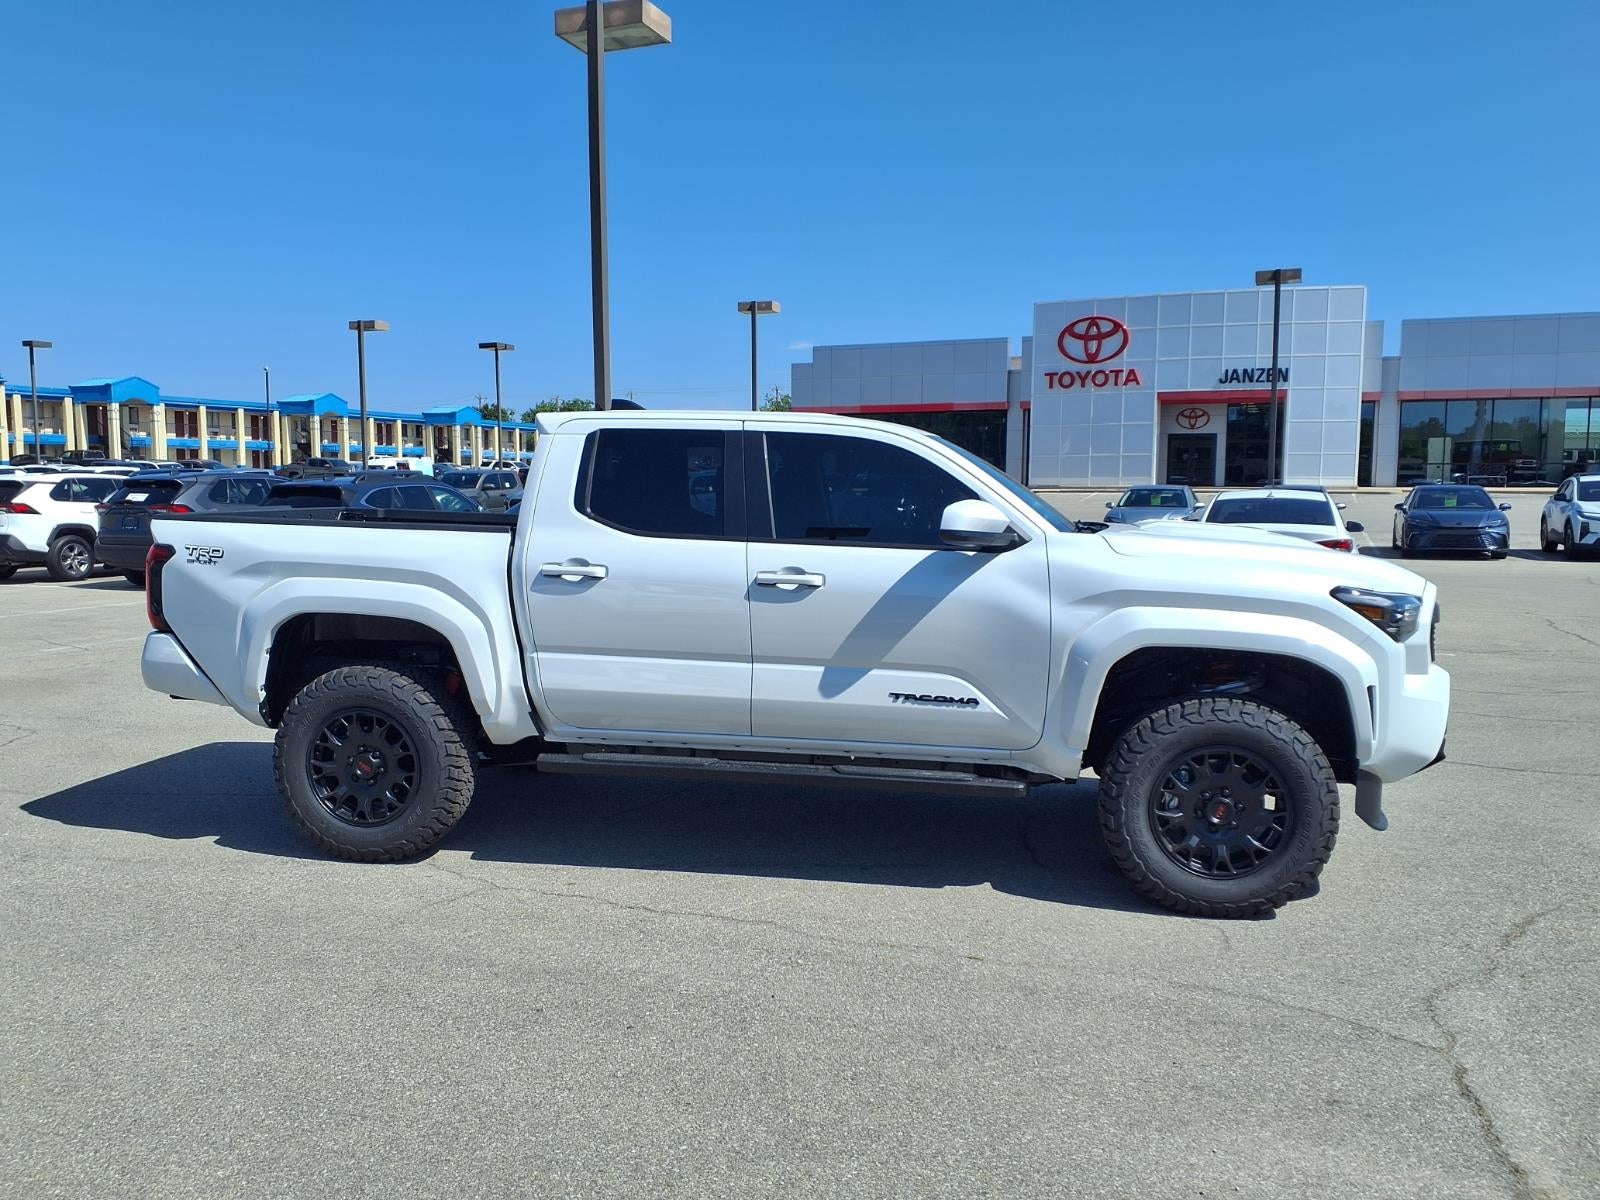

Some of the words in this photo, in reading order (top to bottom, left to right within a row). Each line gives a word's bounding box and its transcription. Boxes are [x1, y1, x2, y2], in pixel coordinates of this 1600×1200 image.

[1044, 369, 1140, 389] TOYOTA
[1219, 367, 1289, 385] JANZEN
[185, 544, 224, 561] TRD
[888, 692, 980, 706] TACOMA
